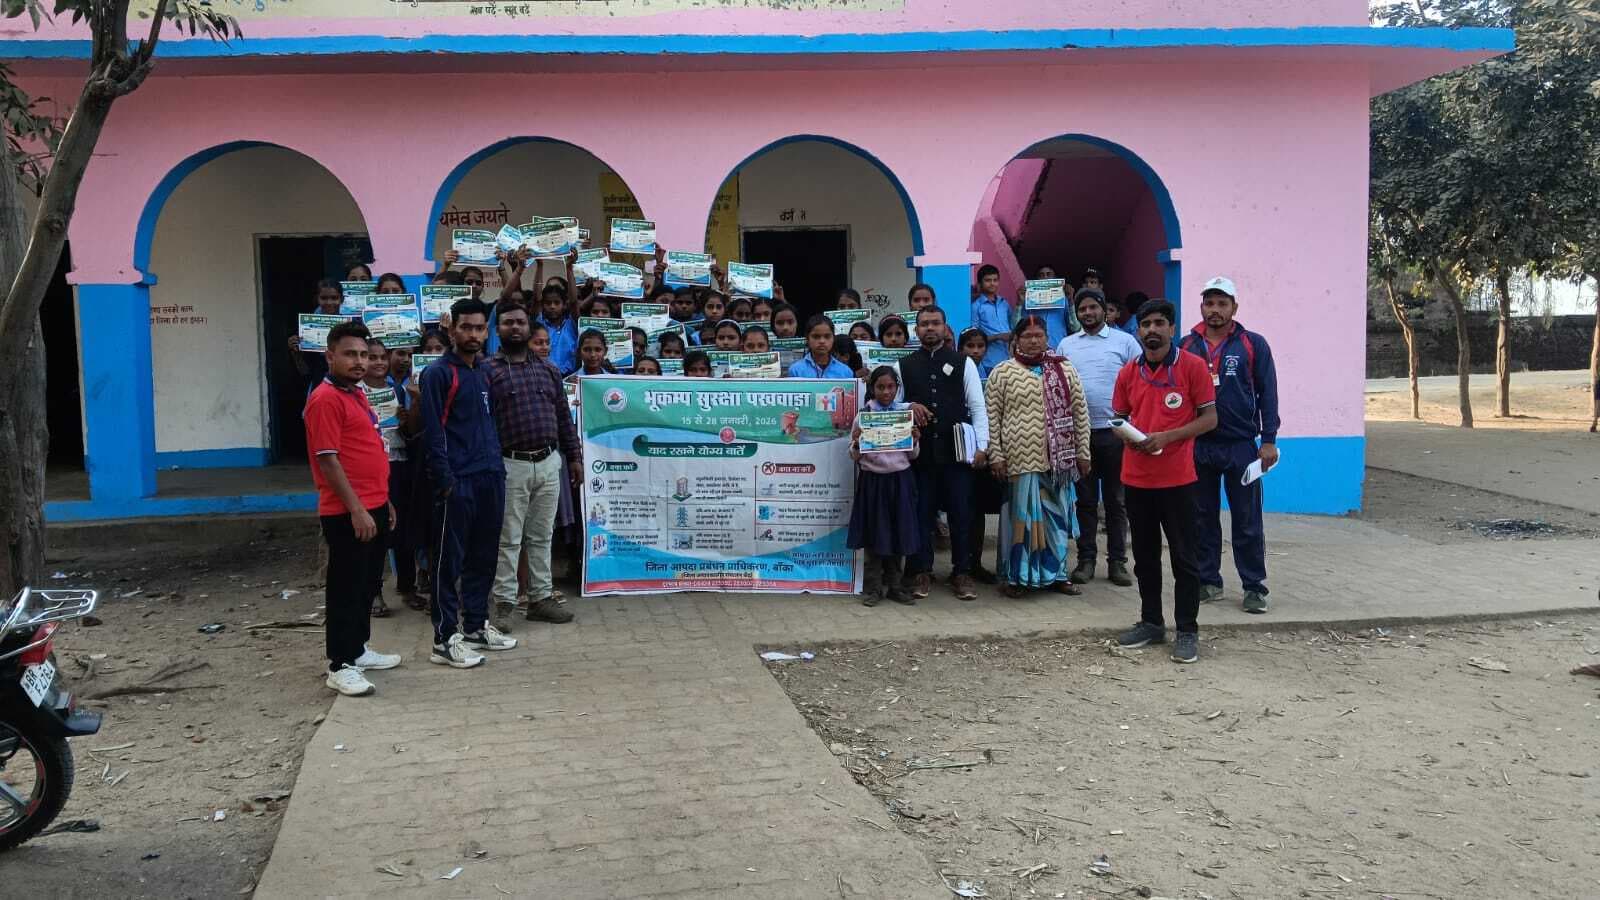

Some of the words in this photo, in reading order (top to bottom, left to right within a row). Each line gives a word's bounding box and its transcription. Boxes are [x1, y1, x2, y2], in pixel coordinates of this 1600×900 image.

[440, 205, 472, 226] यमेव
[473, 202, 512, 224] जयते
[644, 390, 693, 412] भूकम्प
[696, 390, 742, 412] सुरक्षा
[745, 390, 812, 411] पखवाड़ा
[681, 416, 691, 425] 15
[694, 414, 703, 425] से
[755, 416, 777, 425] 2026
[648, 446, 668, 456] याद
[670, 445, 696, 456] रखने
[698, 445, 723, 456] योग्य
[725, 444, 747, 456] बातें
[645, 561, 668, 573] जिला
[670, 562, 697, 572] आपदा
